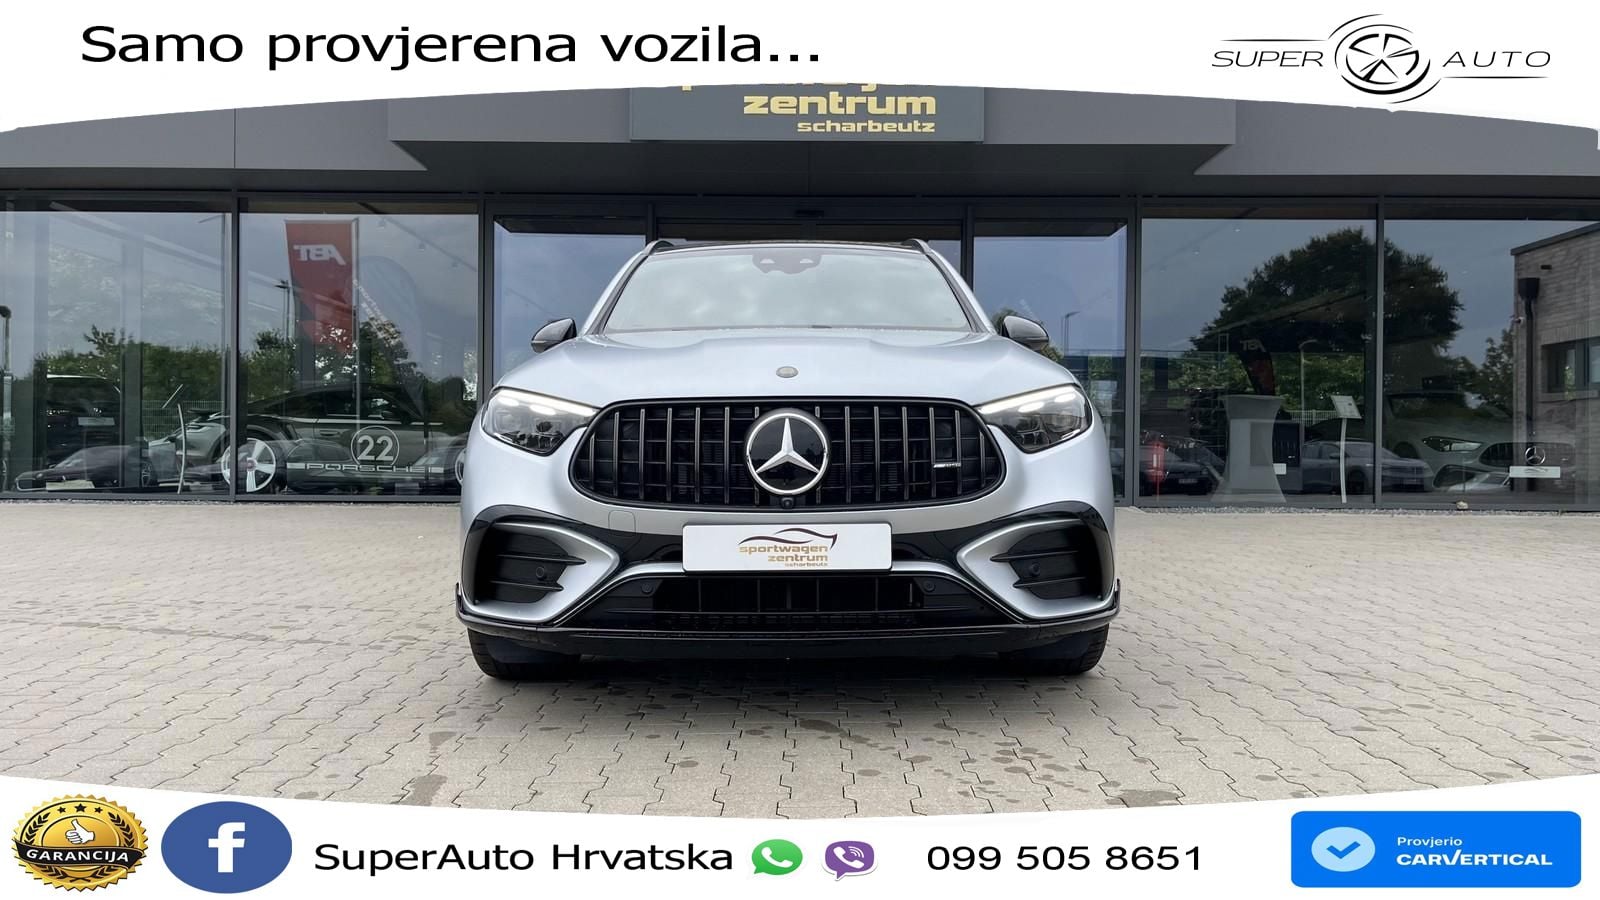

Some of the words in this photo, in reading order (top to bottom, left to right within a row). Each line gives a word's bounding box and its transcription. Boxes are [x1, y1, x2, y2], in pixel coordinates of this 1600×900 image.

[743, 92, 935, 114] zentrum
[797, 119, 935, 132] scharbeutz
[357, 435, 394, 461] 22
[307, 463, 425, 473] PORSCHE
[740, 545, 828, 555] sportwagen
[768, 554, 828, 562] zentrum
